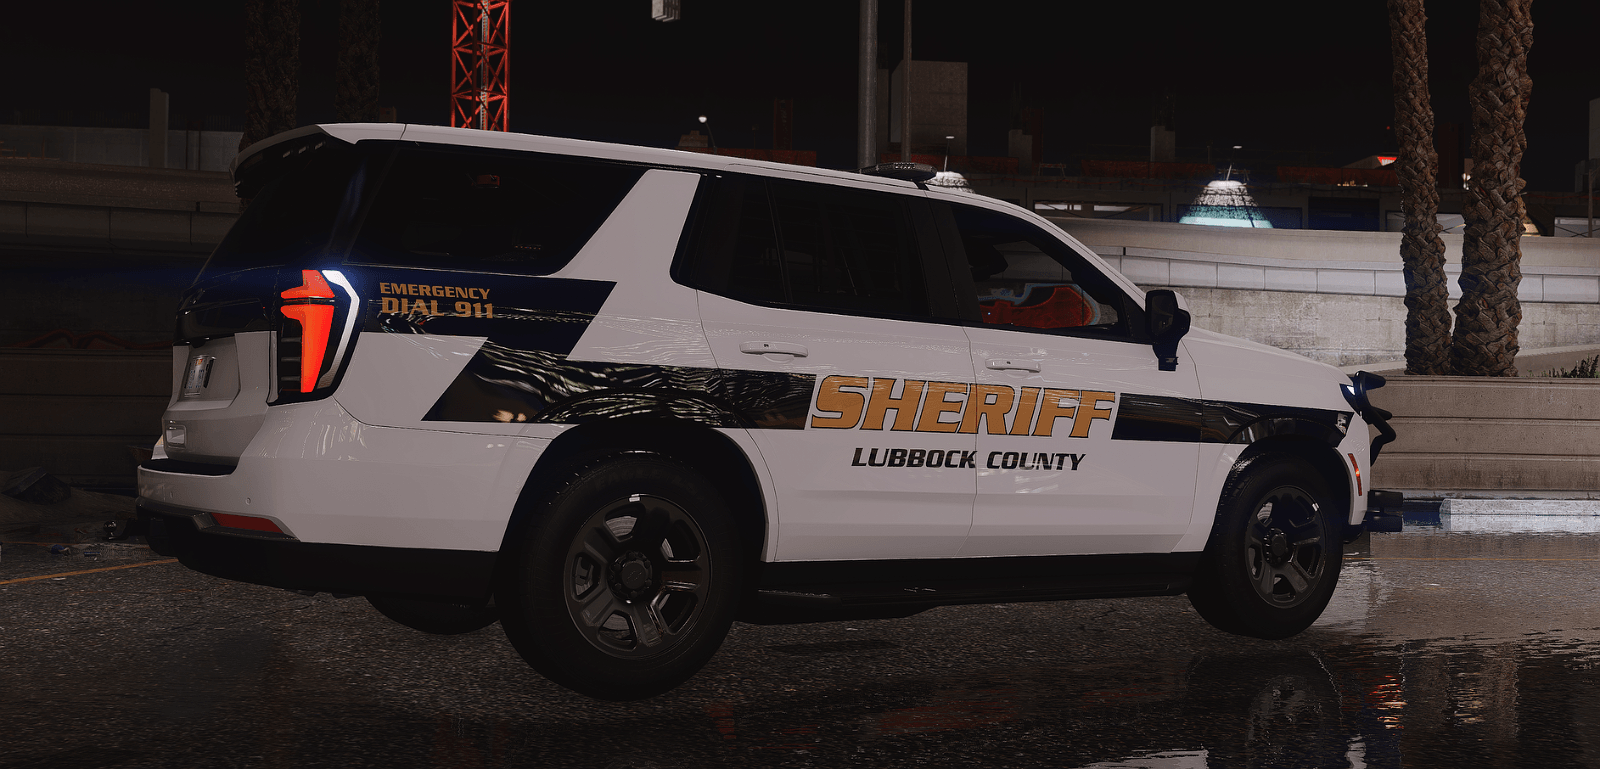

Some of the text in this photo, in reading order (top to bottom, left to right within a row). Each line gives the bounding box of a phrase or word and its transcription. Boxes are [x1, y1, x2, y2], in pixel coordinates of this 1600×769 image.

[379, 282, 490, 300] EMERGENCY
[381, 296, 493, 319] DIAL 911
[810, 374, 1116, 439] SHERIFF
[851, 447, 1087, 471] LUBBOCK COUNTY
